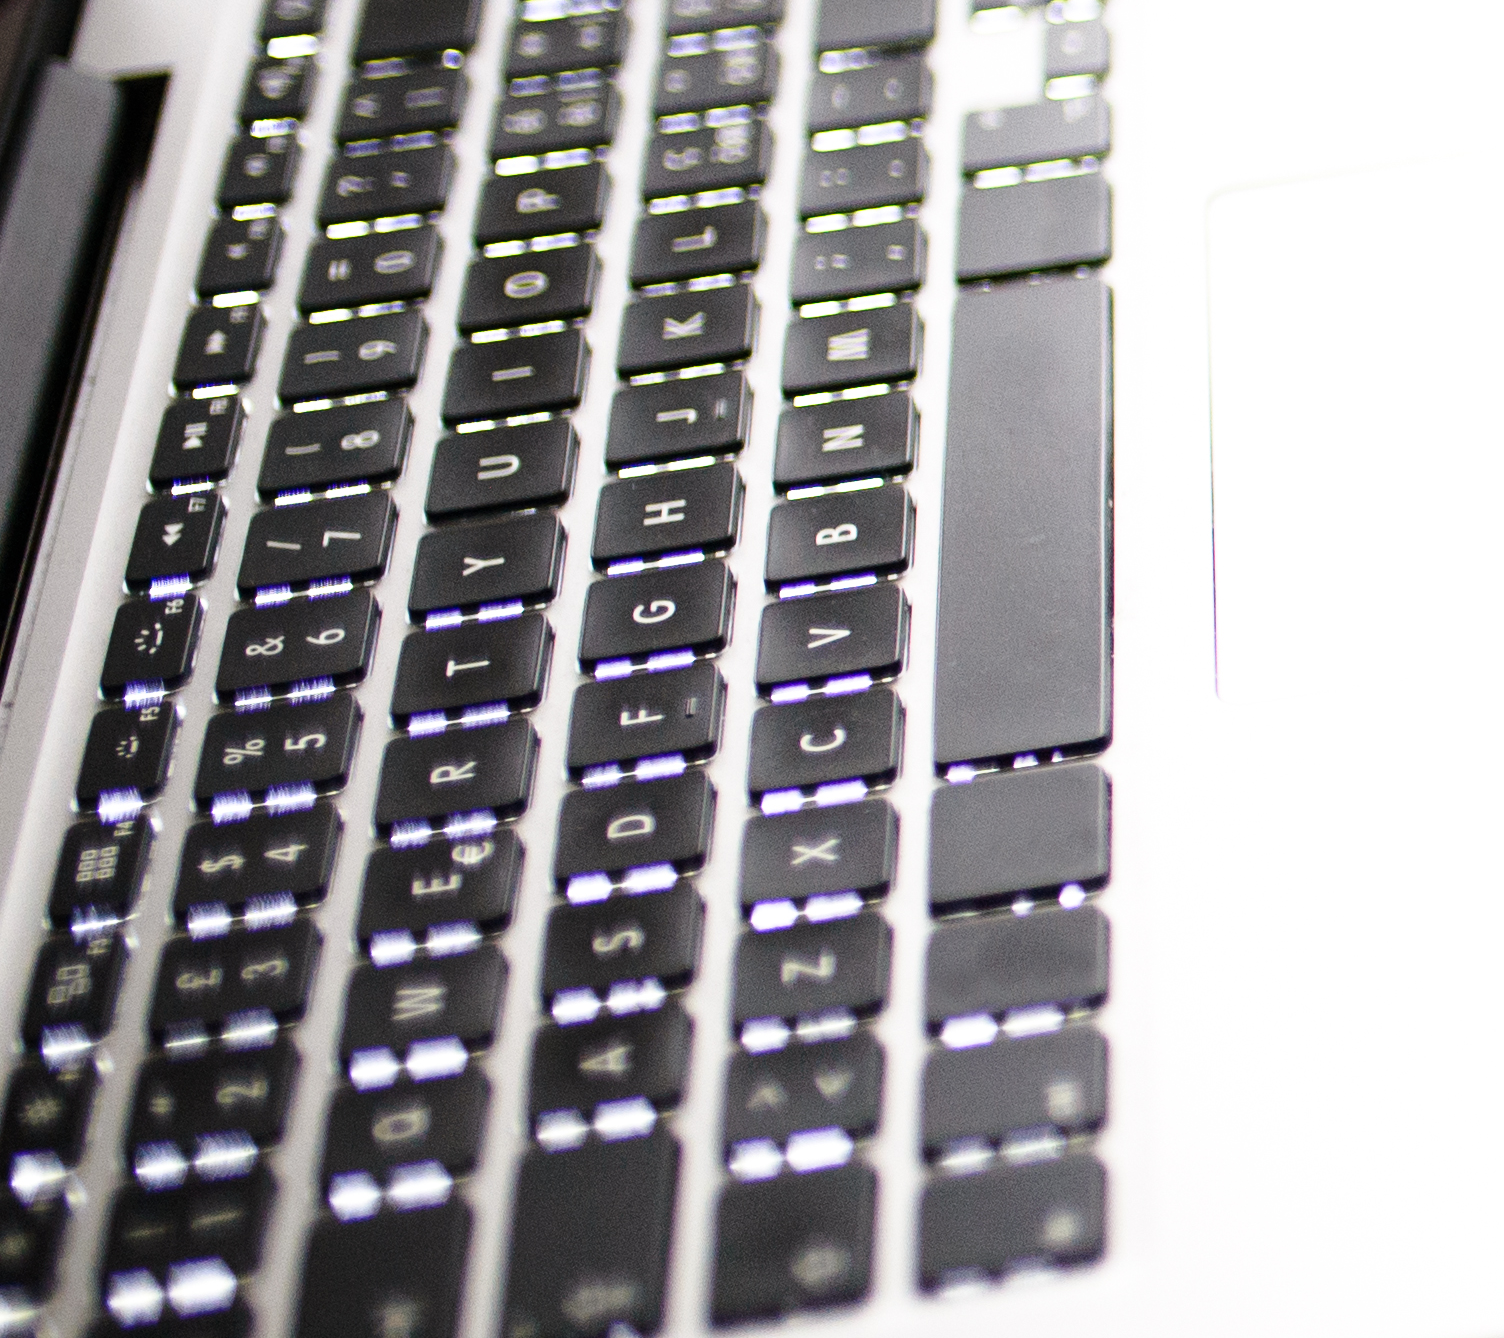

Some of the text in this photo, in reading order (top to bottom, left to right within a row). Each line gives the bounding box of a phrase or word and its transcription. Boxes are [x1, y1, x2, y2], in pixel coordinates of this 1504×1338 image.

[517, 189, 555, 212] P
[674, 227, 716, 251] L
[329, 261, 349, 280] =
[375, 251, 415, 273] 0
[505, 272, 547, 298] O
[664, 313, 703, 339] K
[359, 341, 396, 359] 9
[828, 329, 868, 361] M
[493, 366, 532, 381] I
[657, 409, 697, 423] J
[341, 430, 380, 449] 8
[823, 425, 863, 451] N
[478, 455, 520, 479] U
[644, 500, 686, 525] H
[322, 531, 361, 547] 7
[816, 524, 857, 545] B
[463, 557, 504, 576] Y
[164, 598, 184, 616] F6
[633, 600, 675, 624] G
[245, 636, 284, 656] &
[307, 628, 345, 645] 6
[808, 628, 850, 648] V
[446, 660, 489, 677] T
[140, 706, 159, 723] F5
[620, 709, 663, 726] F
[223, 738, 265, 765] %
[285, 733, 326, 750] 5
[800, 728, 846, 753] C
[430, 761, 475, 784] R
[607, 814, 655, 839] D
[267, 839, 309, 863] 4
[452, 842, 493, 865] €
[792, 838, 838, 865] X
[199, 854, 244, 874] $
[412, 874, 461, 896] E
[593, 928, 644, 953] S
[241, 957, 290, 983] 3
[782, 954, 835, 982] Z
[395, 985, 445, 1020] W
[581, 1046, 628, 1074] A
[217, 1080, 267, 1105] 2
[374, 1107, 428, 1142] Q
